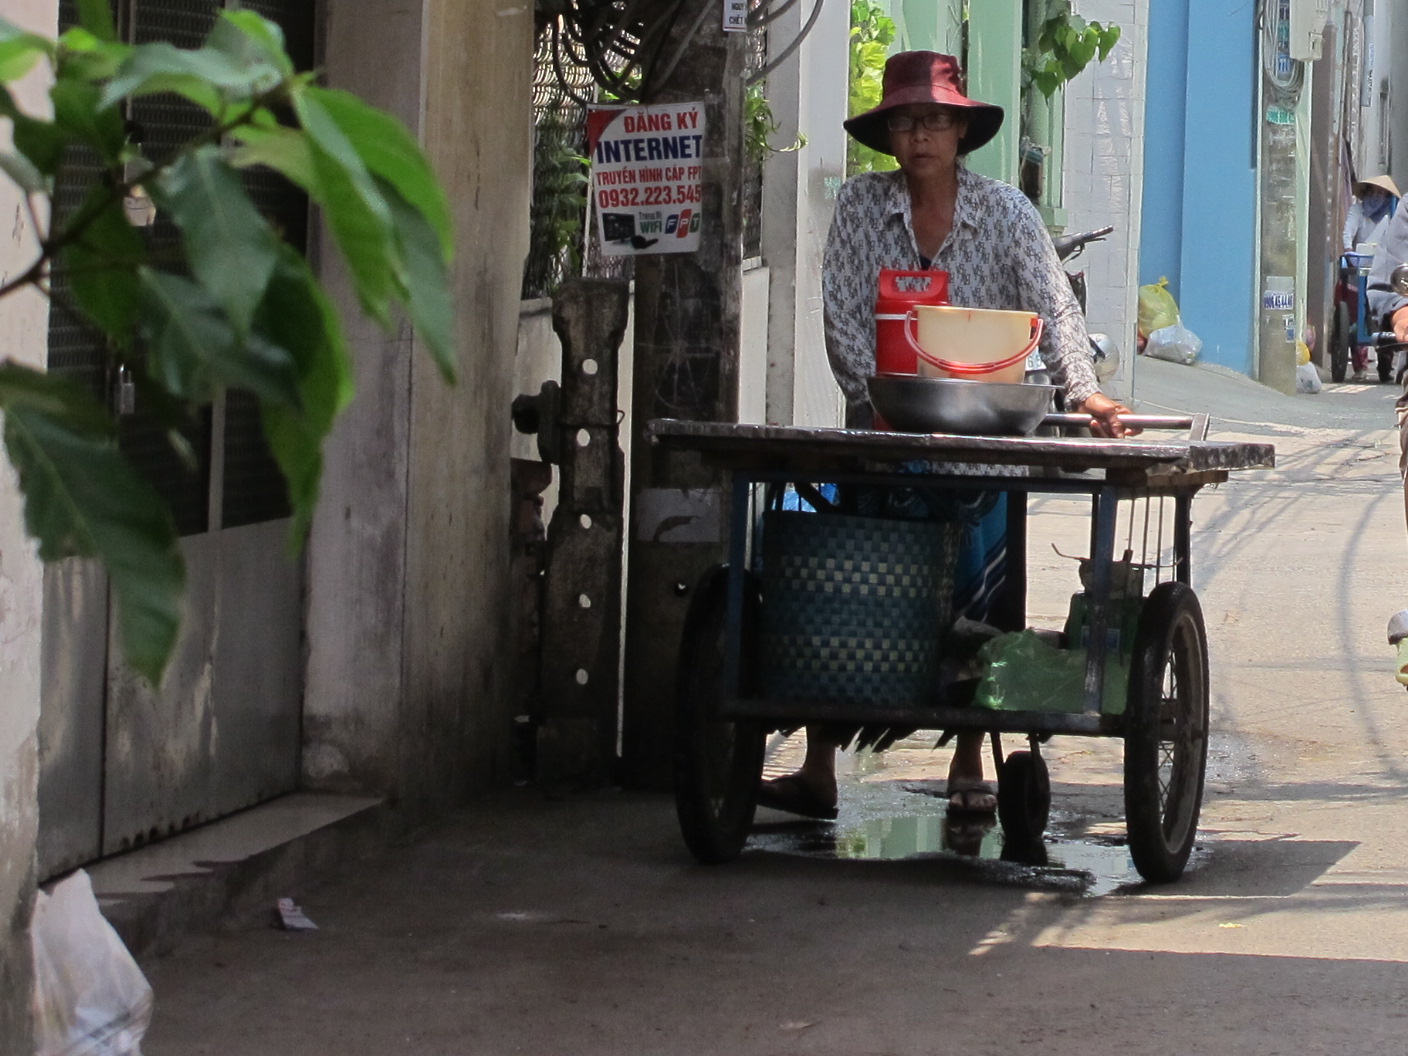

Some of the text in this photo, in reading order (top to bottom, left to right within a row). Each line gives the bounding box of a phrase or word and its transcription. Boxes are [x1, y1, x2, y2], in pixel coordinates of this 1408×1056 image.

[623, 111, 672, 134] ĐĂNG
[597, 135, 703, 164] INTERNET
[598, 184, 702, 208] 0932.223.545
[640, 220, 662, 233] WIFI
